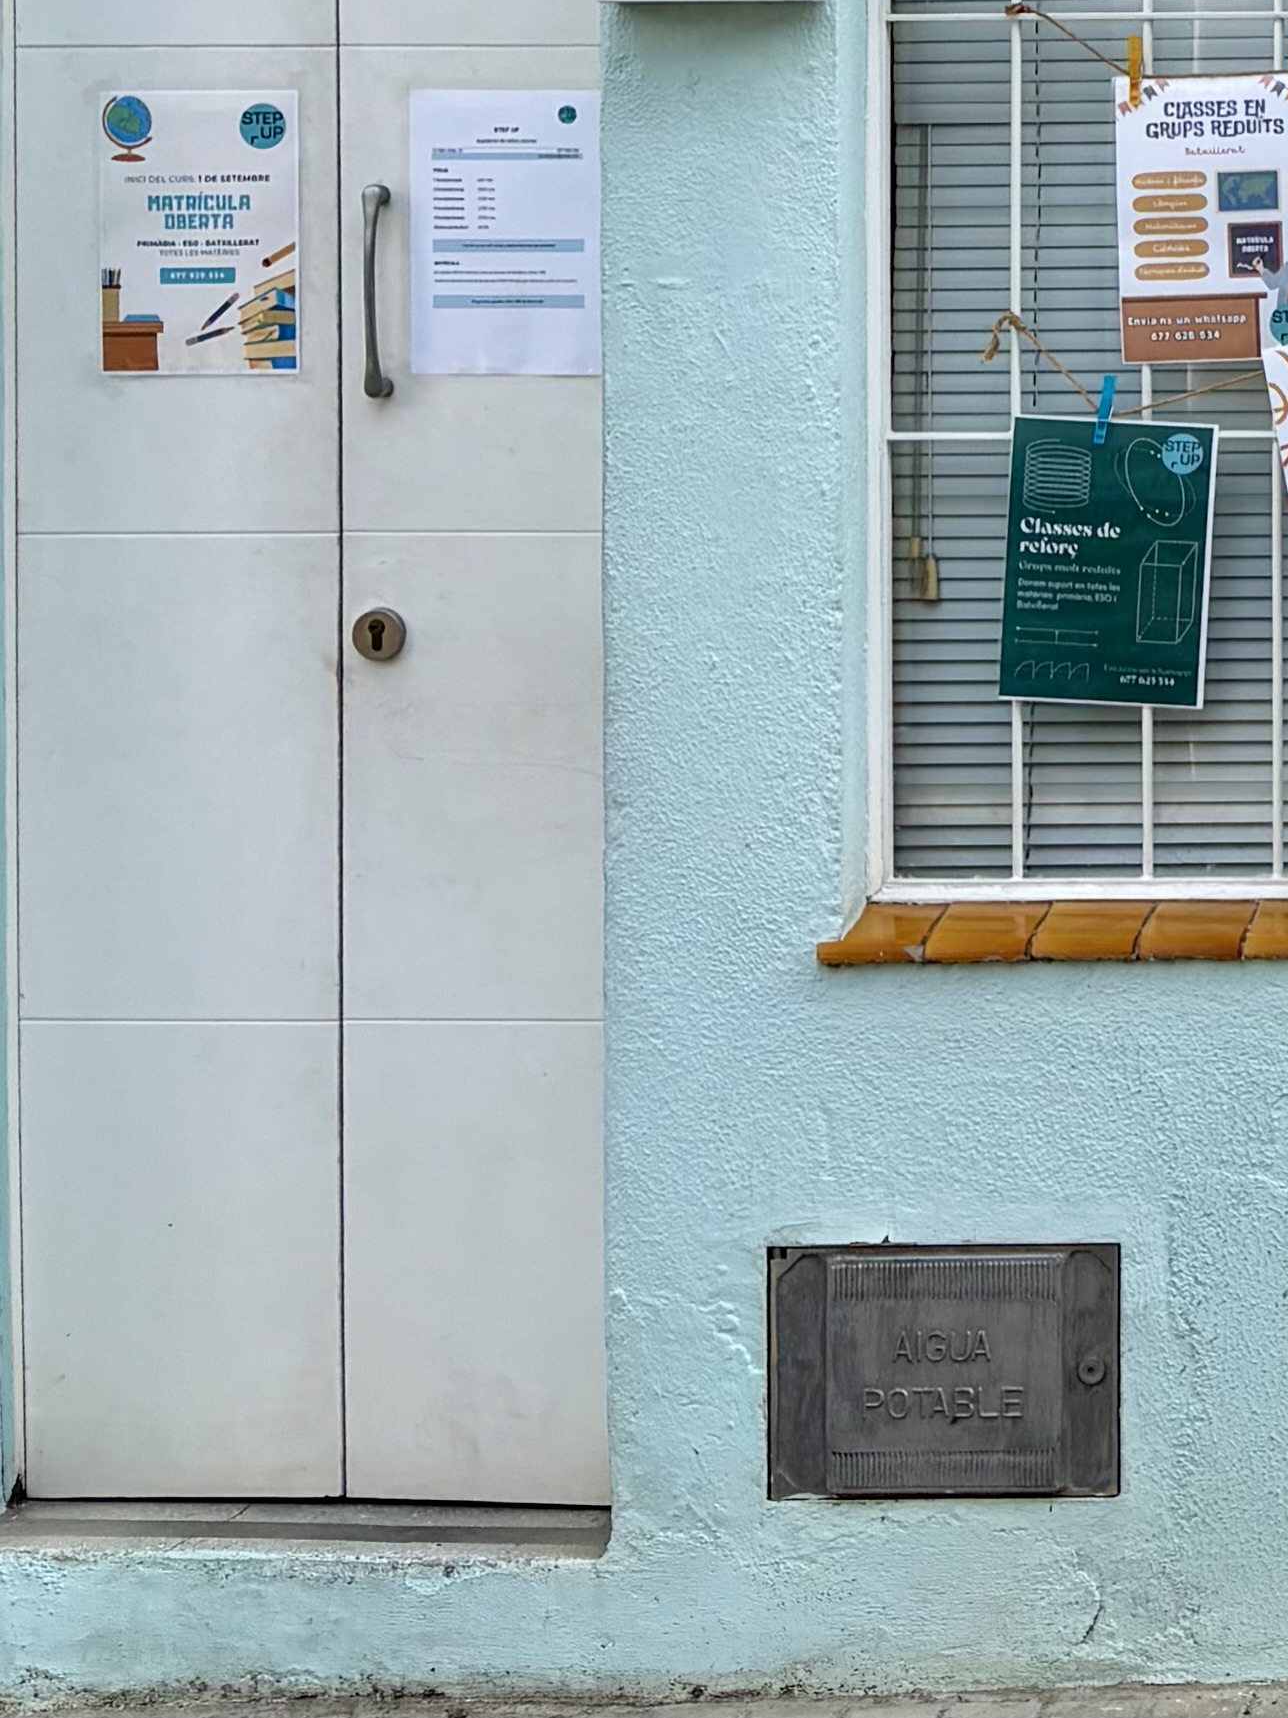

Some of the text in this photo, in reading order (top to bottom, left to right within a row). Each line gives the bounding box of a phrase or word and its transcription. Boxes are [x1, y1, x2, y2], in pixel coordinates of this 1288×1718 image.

[241, 111, 284, 125] STEP
[1163, 99, 1266, 119] CLASSES EN
[261, 126, 284, 139] UP
[1146, 115, 1285, 139] GRUPS REDUÏTS
[149, 175, 166, 183] DEL
[204, 175, 218, 183] DE
[221, 174, 270, 183] SETEMBRE
[147, 191, 251, 211] MATRÍCULA
[164, 213, 234, 229] OBERTA
[1165, 440, 1200, 452] STEP
[1180, 453, 1200, 466] UP
[1020, 517, 1121, 539] Classes de
[1020, 537, 1078, 559] reforç
[893, 1330, 991, 1363] AIGUA
[863, 1386, 1024, 1420] POTABLE
